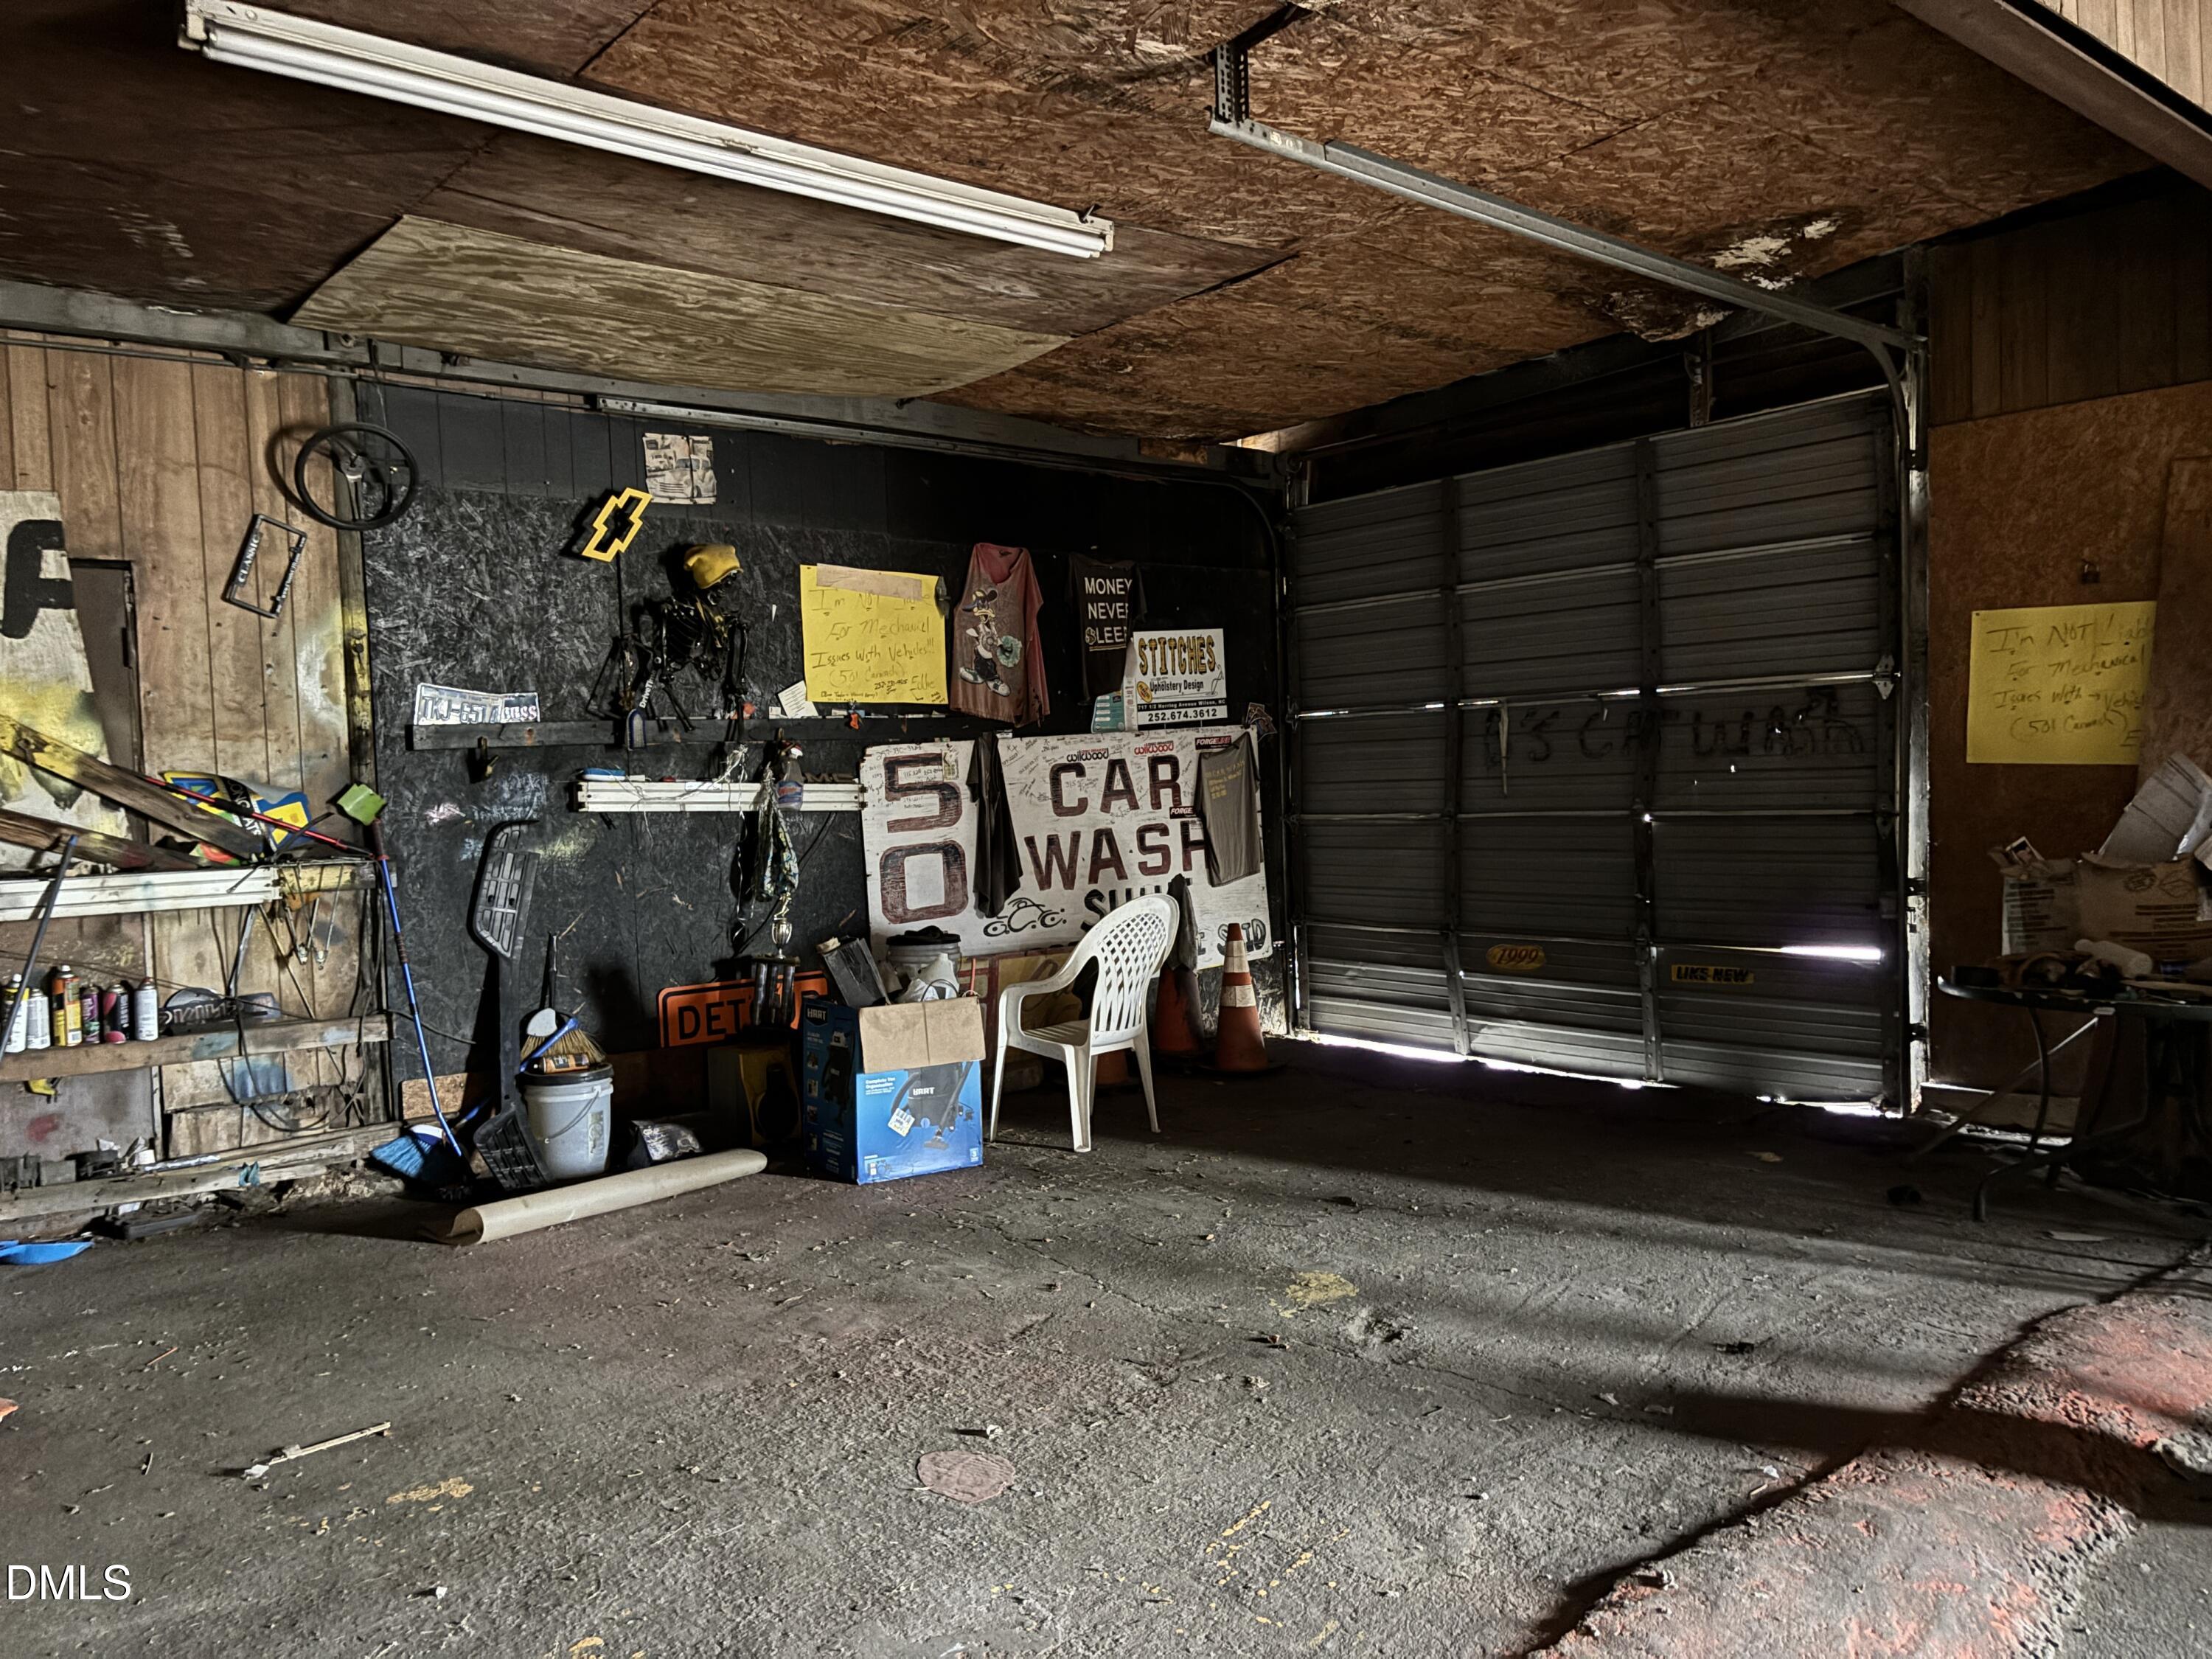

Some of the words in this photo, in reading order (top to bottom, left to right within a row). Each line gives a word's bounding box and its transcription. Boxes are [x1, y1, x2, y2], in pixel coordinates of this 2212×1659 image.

[1084, 577, 1133, 595] MONEY
[2047, 622, 2095, 644] NOT
[810, 650, 851, 669] Issues
[855, 644, 881, 661] With
[1138, 634, 1217, 677] STITCHES
[1150, 679, 1182, 695] Upholstery
[1183, 679, 1204, 692] Design
[1147, 708, 1218, 723] 252.674.3612
[1066, 748, 1109, 762] wilwood
[1134, 740, 1174, 755] wilwood
[1049, 754, 1183, 818] CAR
[1023, 821, 1210, 891] WASH
[1496, 948, 1539, 965] 1999
[1677, 966, 1709, 981] LIKE
[1712, 967, 1749, 983] NEW
[807, 1007, 827, 1021] HART
[913, 1087, 936, 1096] HART
